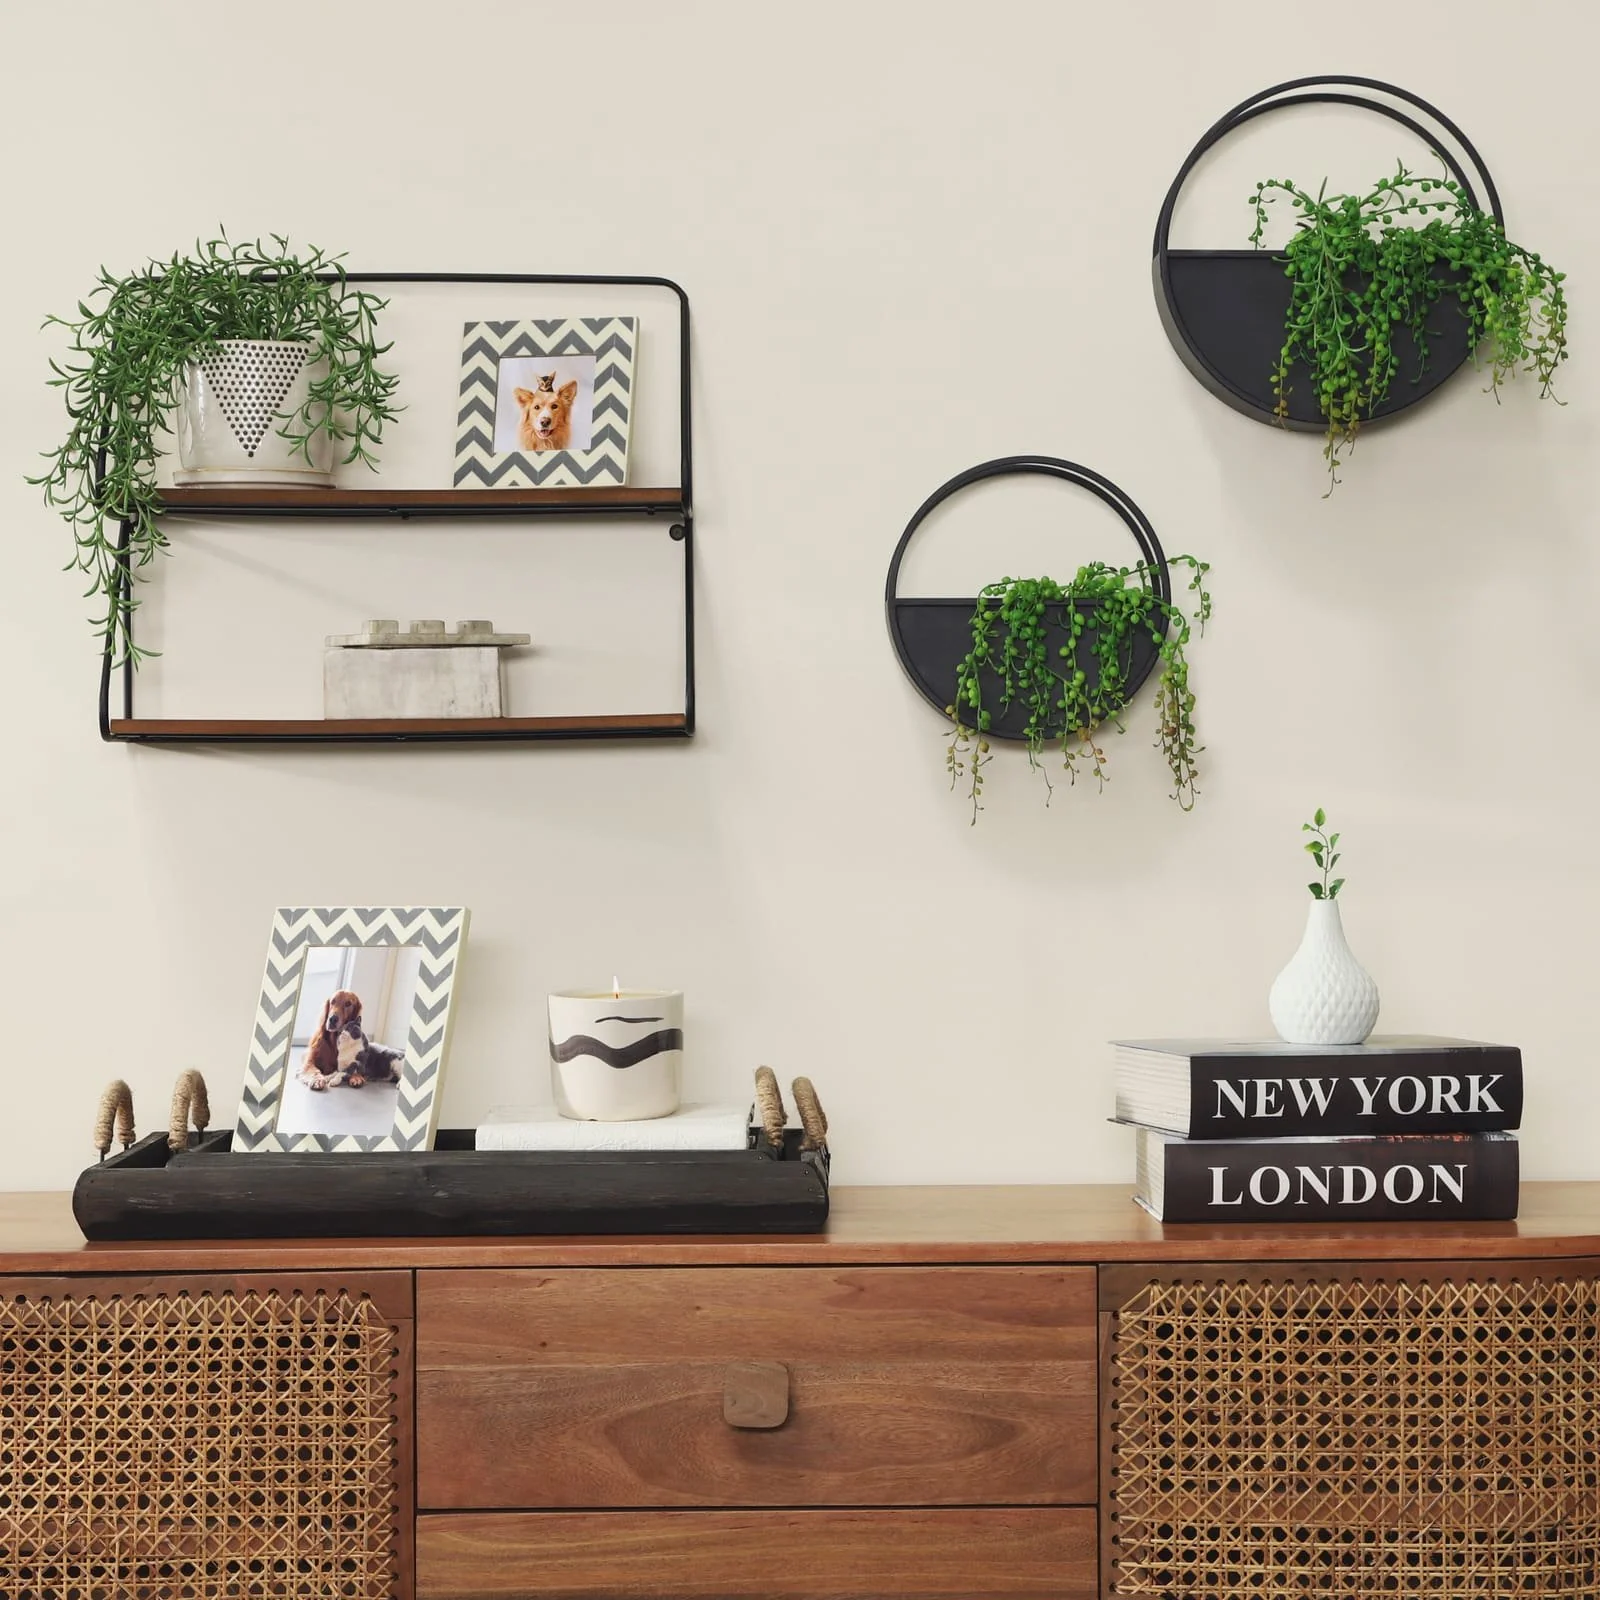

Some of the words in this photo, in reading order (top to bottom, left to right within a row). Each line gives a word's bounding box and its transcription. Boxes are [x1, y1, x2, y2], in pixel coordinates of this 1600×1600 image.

[1212, 1078, 1339, 1119] NEW
[1349, 1074, 1505, 1116] YORK
[1207, 1164, 1468, 1206] LONDON
